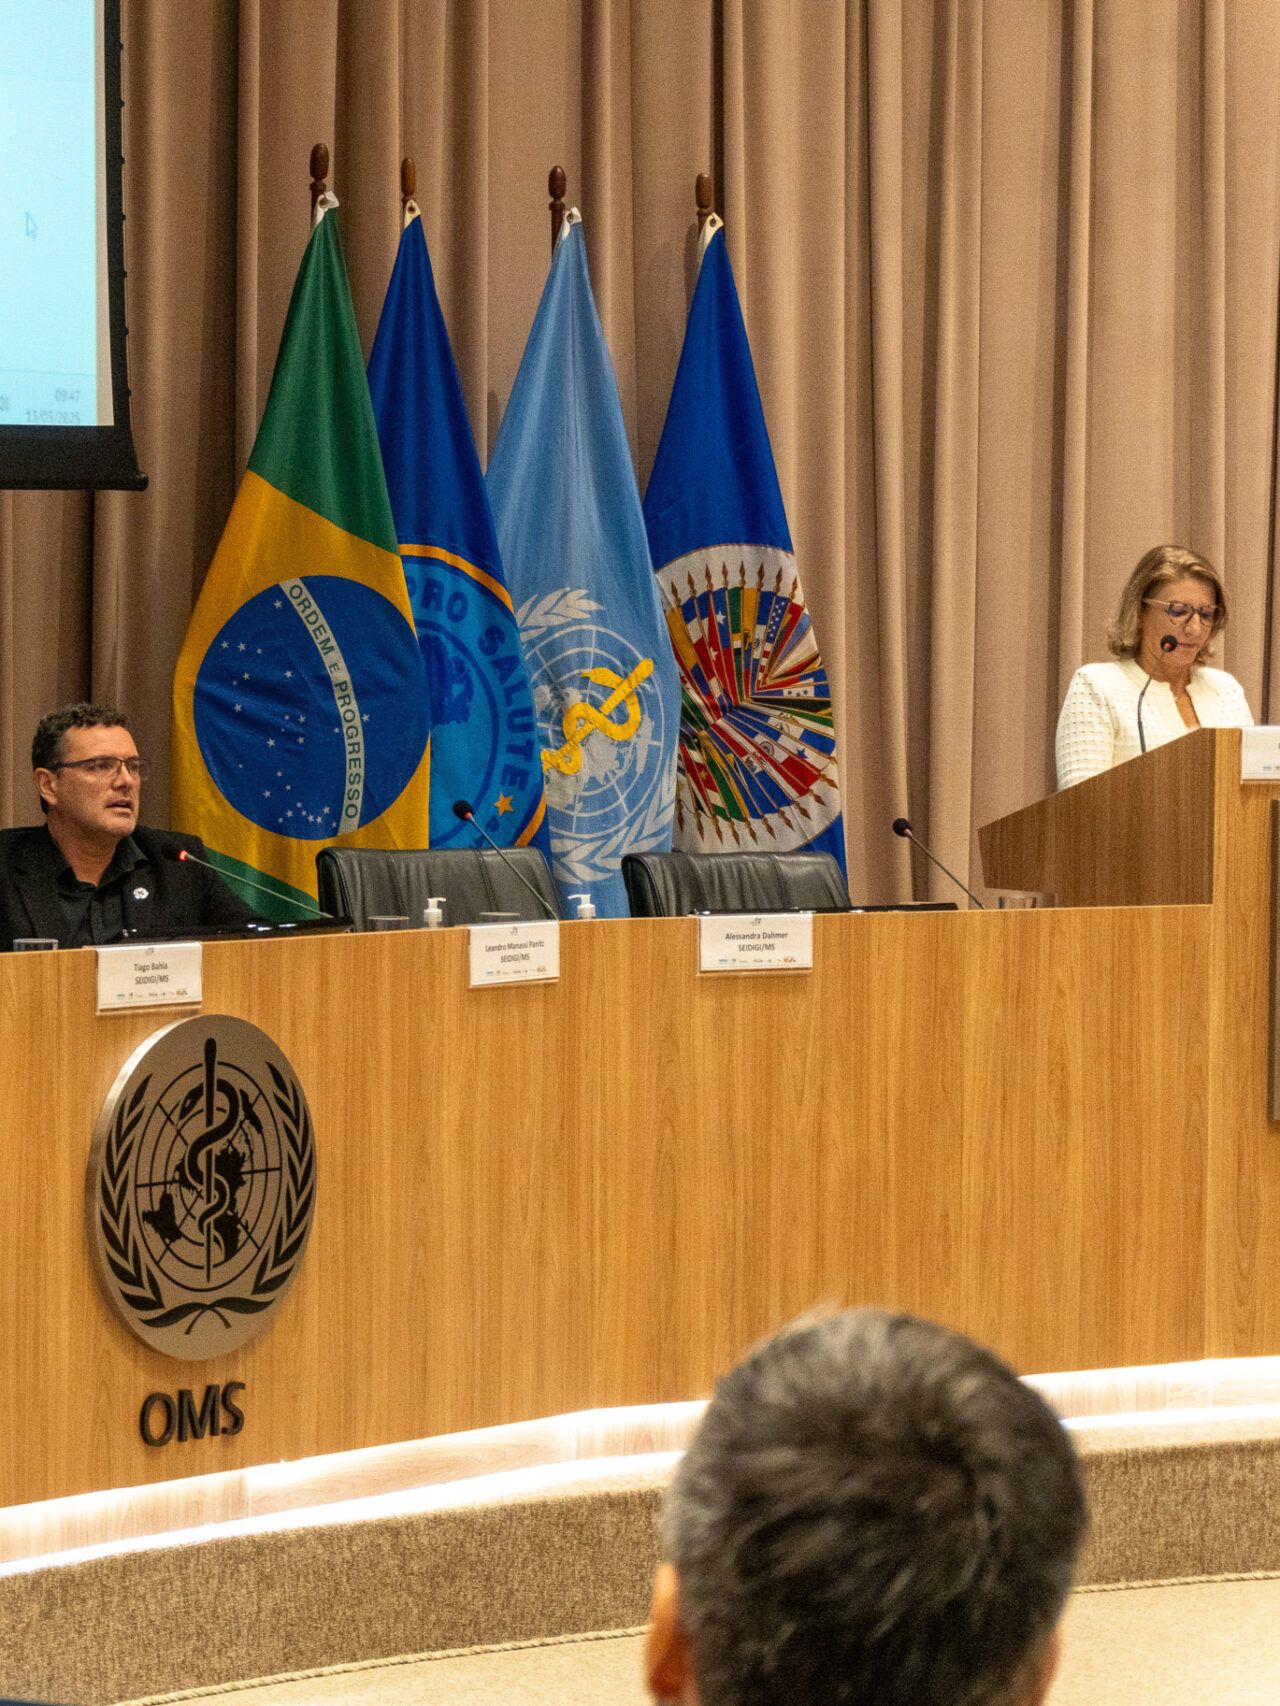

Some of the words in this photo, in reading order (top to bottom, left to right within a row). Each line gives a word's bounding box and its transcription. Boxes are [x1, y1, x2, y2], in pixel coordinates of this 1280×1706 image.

[289, 584, 335, 656] ORDEM
[328, 662, 340, 674] E
[334, 680, 362, 819] PROGRESSO
[477, 625, 536, 792] SALUTE
[725, 932, 761, 941] Alessandra
[762, 931, 789, 940] Dahmer
[485, 944, 507, 953] Leandro
[738, 943, 776, 952] SEIDIGI/MS
[133, 963, 151, 973] Tiago
[151, 961, 168, 970] Bahia
[134, 974, 169, 985] SEIDIGI/MS
[139, 1381, 246, 1447] OMS
